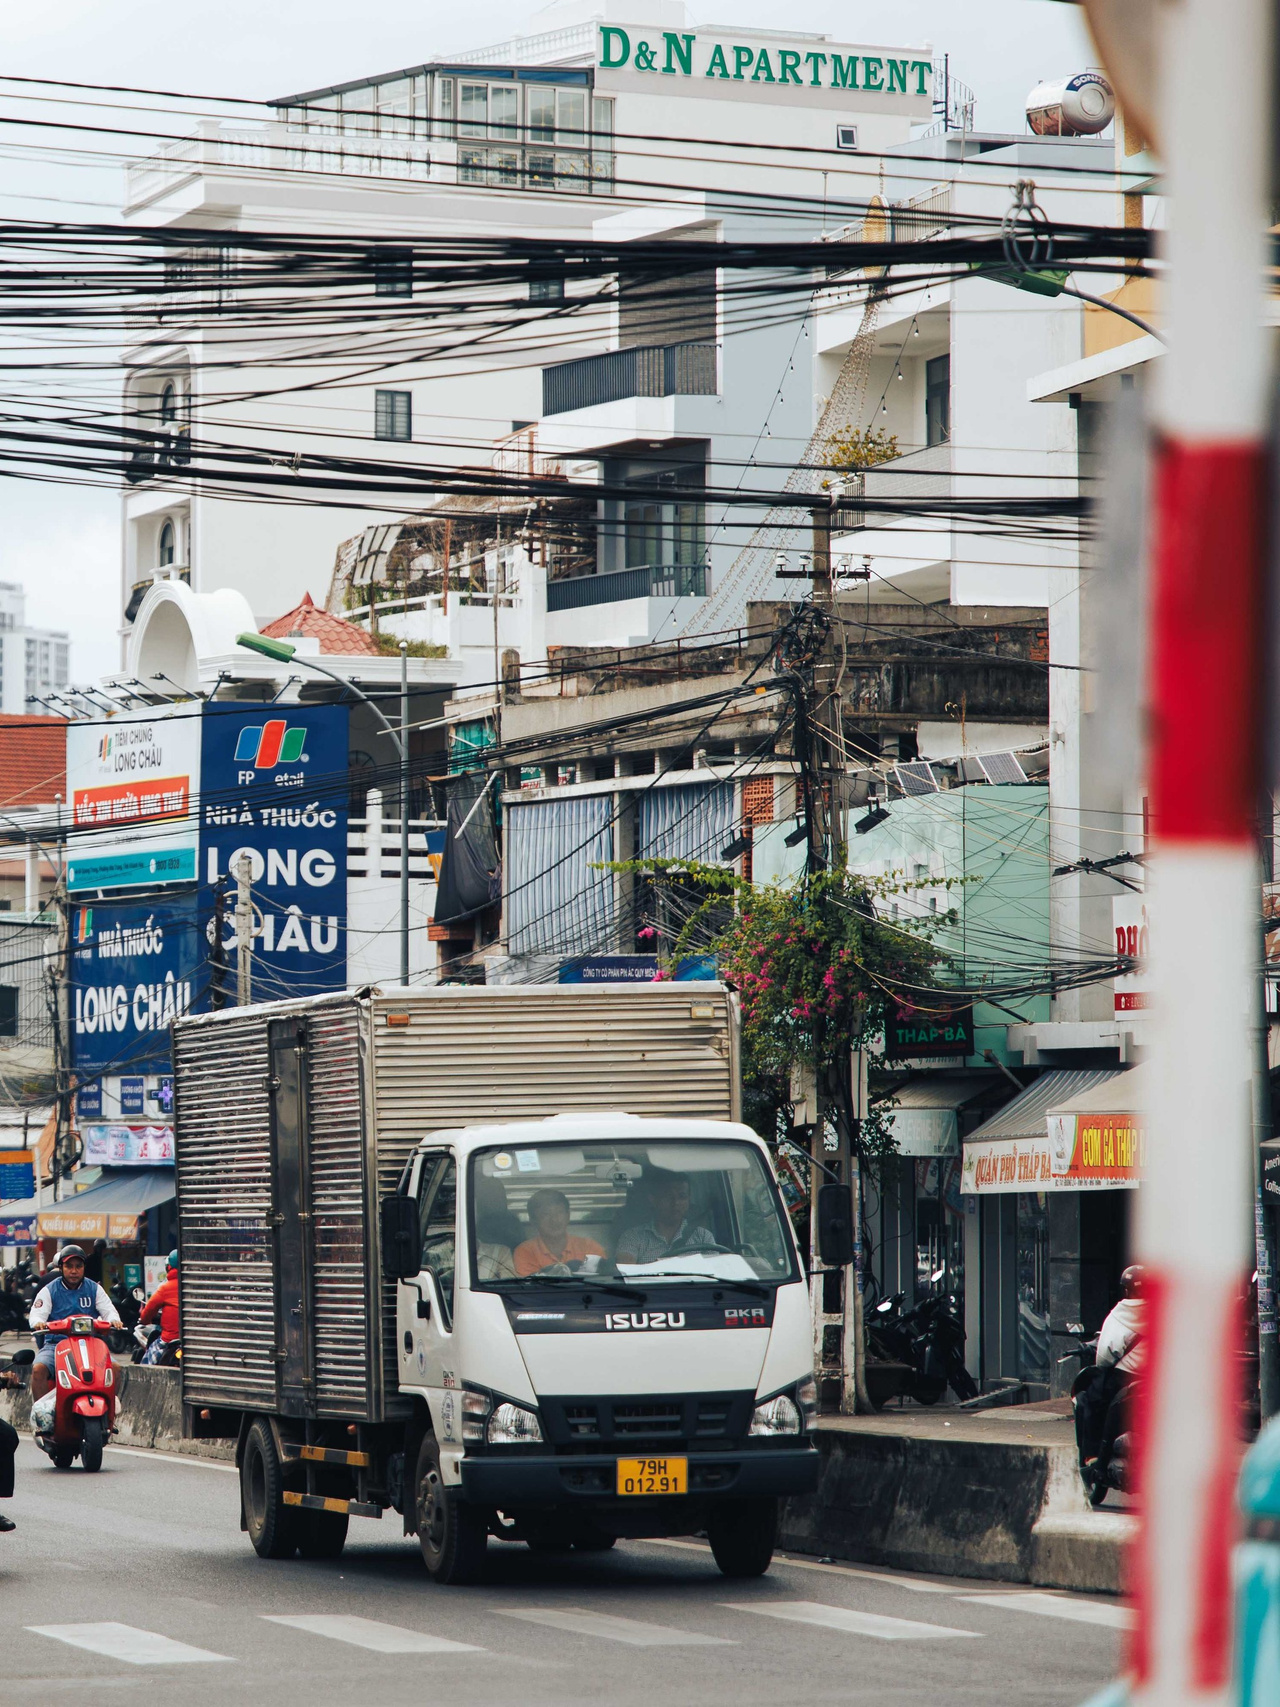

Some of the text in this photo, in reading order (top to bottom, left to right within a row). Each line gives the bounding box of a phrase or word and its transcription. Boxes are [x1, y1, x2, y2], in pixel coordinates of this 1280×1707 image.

[599, 26, 934, 95] D&N APARTMENT
[114, 743, 163, 773] LONG CHÂU
[205, 800, 337, 828] NHÀ THUỐC
[207, 846, 337, 887] LONG
[98, 913, 163, 958] NHÀ THUỐC
[205, 904, 339, 954] CHÂU
[75, 970, 191, 1034] LONG CHÂU
[943, 1022, 967, 1042] BÀ
[1082, 1119, 1138, 1168] CƠM GÀ THÁP
[975, 1148, 1000, 1191] QUÁN
[999, 1143, 1018, 1183] PHỞ
[1017, 1143, 1040, 1184] THÁP
[605, 1308, 765, 1330] ISUZU QKR
[725, 1317, 766, 1326] 210
[624, 1477, 679, 1493] 012.91
[637, 1460, 668, 1475] 79H
